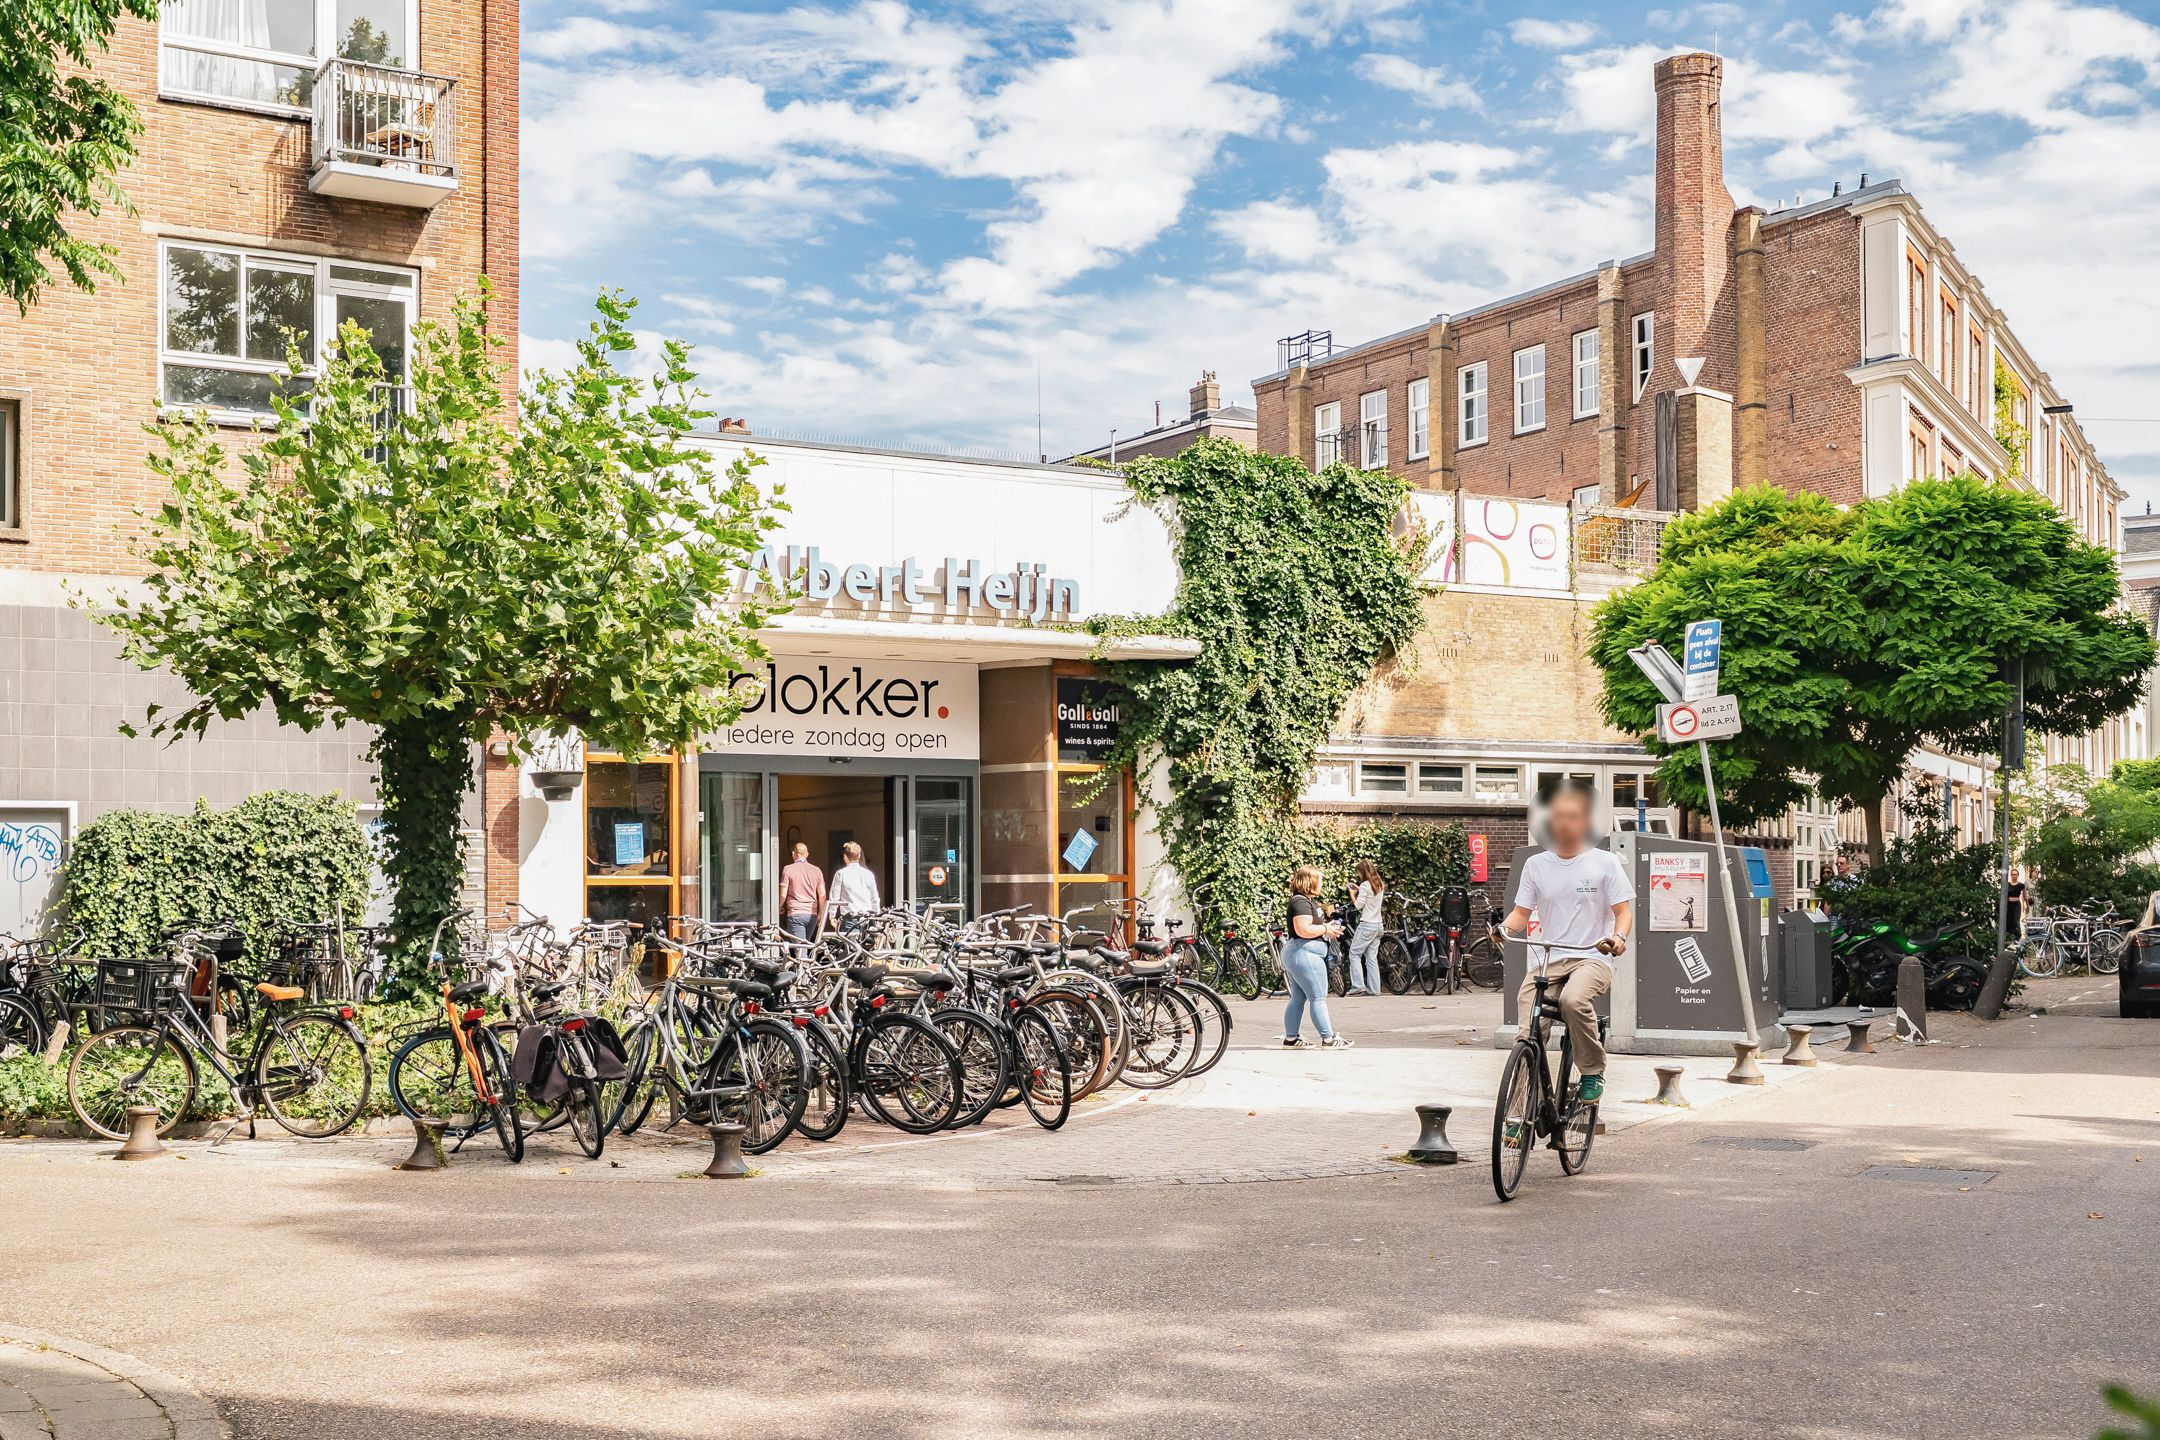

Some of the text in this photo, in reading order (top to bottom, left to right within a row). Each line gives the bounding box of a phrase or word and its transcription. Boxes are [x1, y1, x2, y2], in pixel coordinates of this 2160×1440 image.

[743, 544, 1080, 623] Albert Heijn
[1696, 628, 1713, 637] Plaats
[1689, 636, 1718, 650] geen afval
[1694, 649, 1712, 660] bij de
[1689, 660, 1716, 671] container
[1701, 704, 1733, 715] ART. 2.17
[727, 725, 947, 752] iedere zondag open
[1065, 737, 1115, 747] wines & spirits
[1675, 987, 1700, 995] Papier
[1680, 996, 1706, 1004] karton
